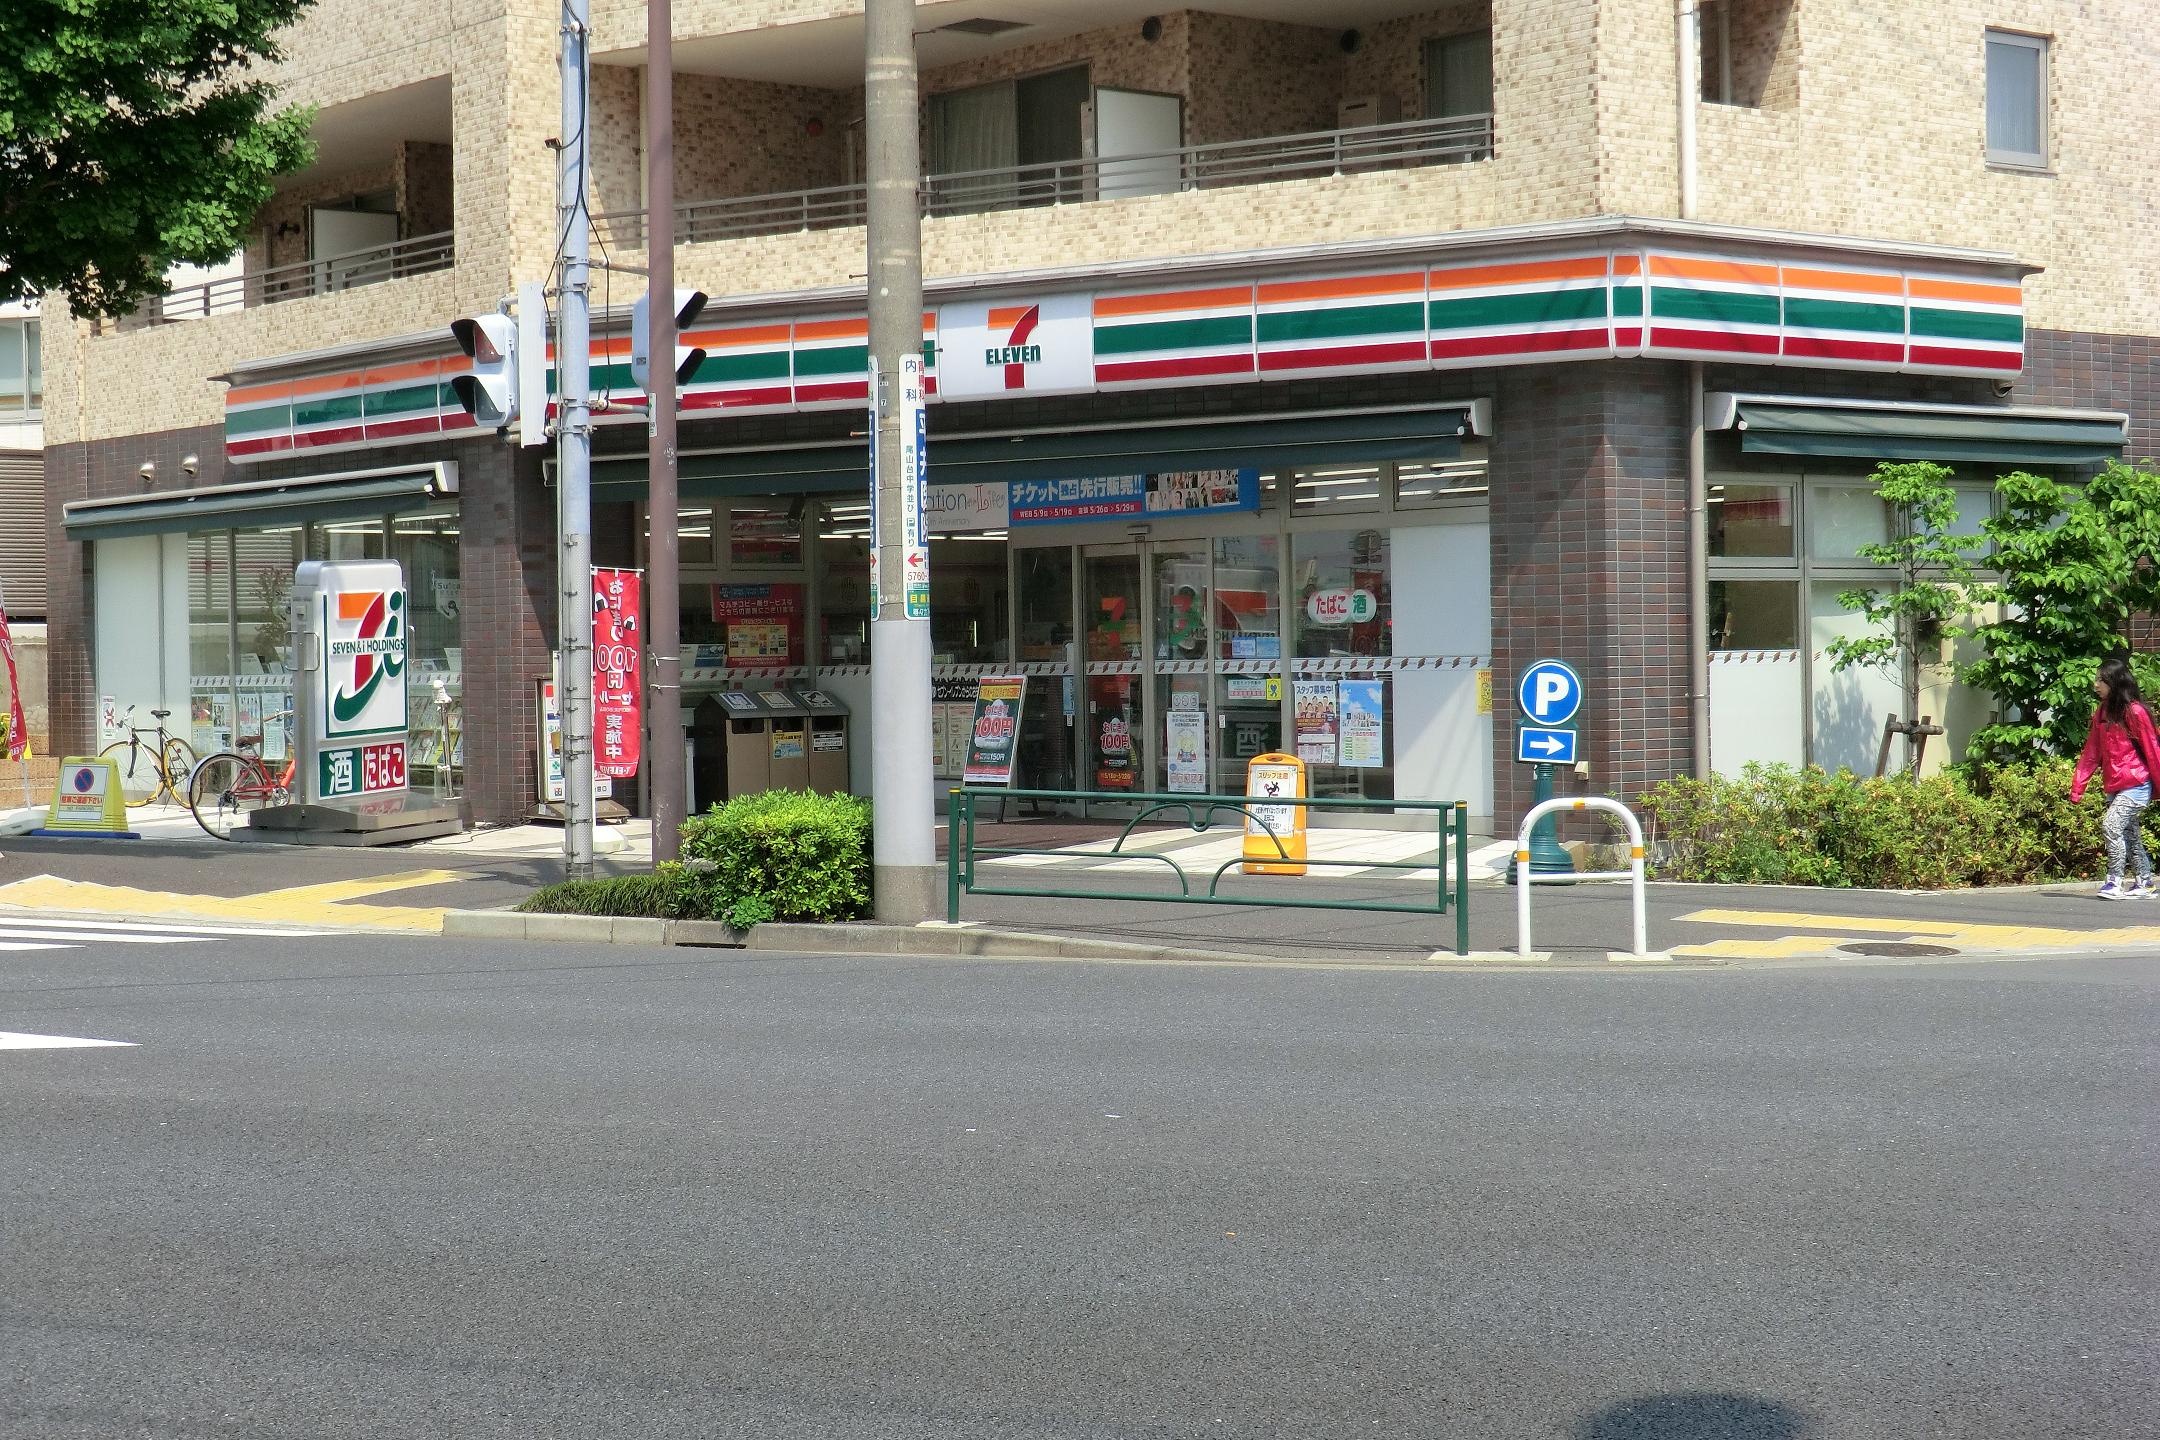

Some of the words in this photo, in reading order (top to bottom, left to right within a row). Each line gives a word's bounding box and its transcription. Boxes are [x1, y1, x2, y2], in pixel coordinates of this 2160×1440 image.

[905, 359, 917, 402] 内科
[905, 445, 916, 512] 尾山台中学並び
[1020, 510, 1032, 518] WEB
[1316, 595, 1347, 614] たばこ
[1353, 595, 1367, 613] 酒
[367, 639, 405, 652] HOLDINGS
[1535, 672, 1569, 715] P
[975, 717, 1014, 737] 100円
[1101, 734, 1131, 749] 100円
[328, 750, 353, 795] 酒
[364, 745, 404, 789] たばこ
